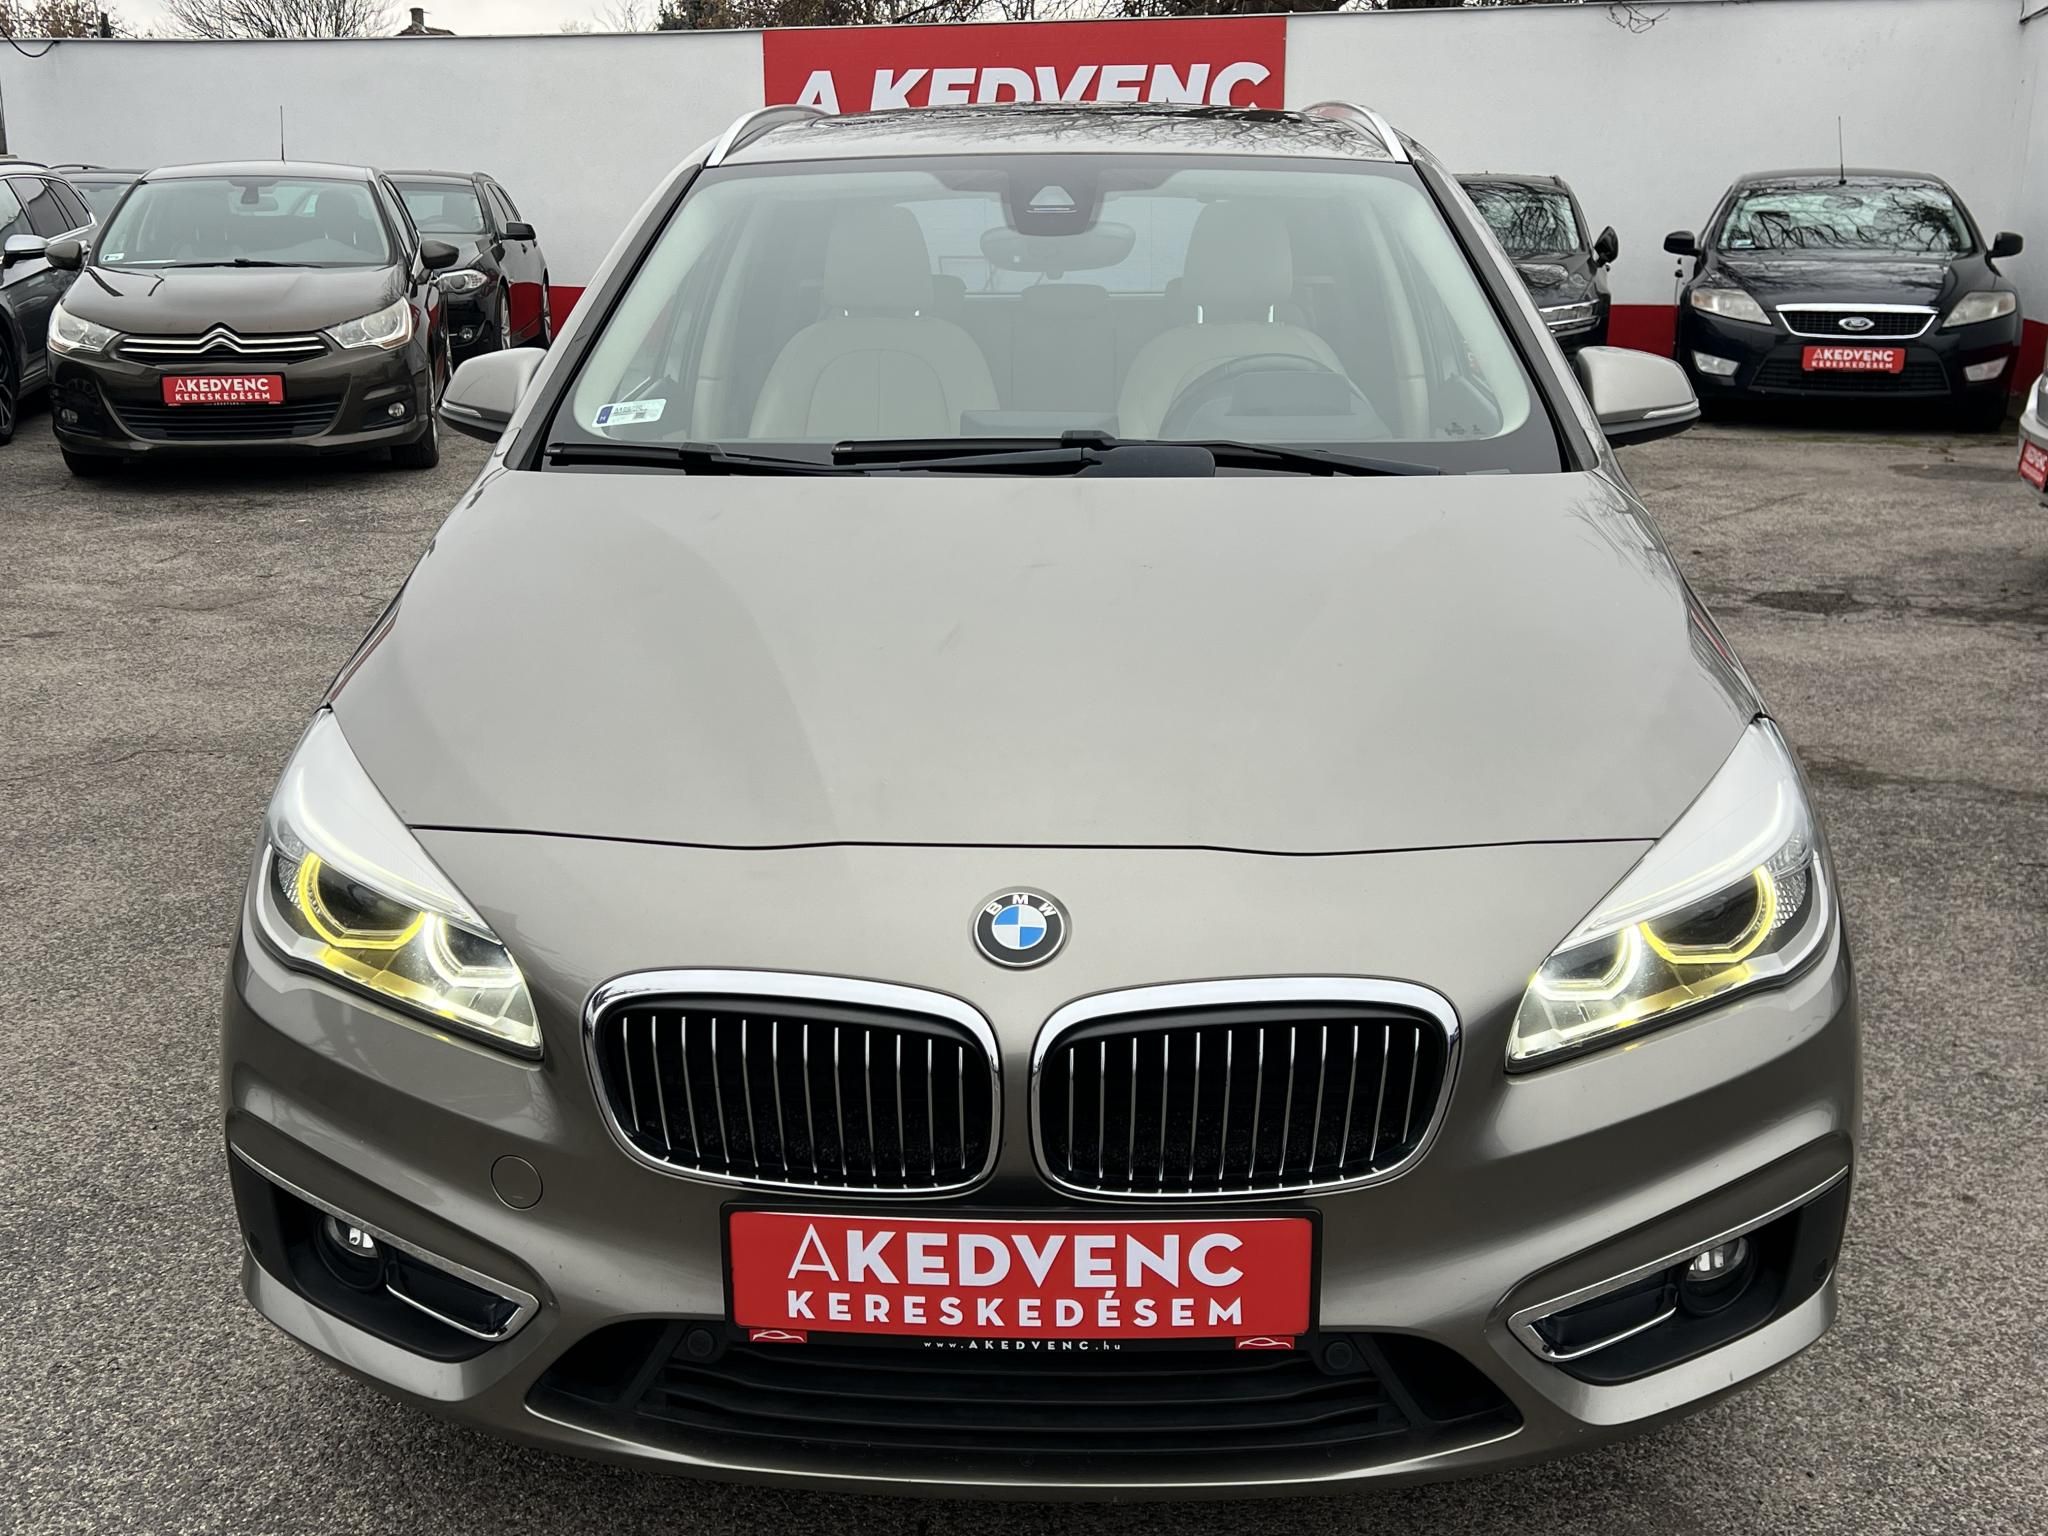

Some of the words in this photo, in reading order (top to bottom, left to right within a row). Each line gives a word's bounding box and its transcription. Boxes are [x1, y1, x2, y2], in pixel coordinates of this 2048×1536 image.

[796, 70, 842, 116] A
[870, 60, 1272, 111] KEDVENC
[1813, 349, 1894, 361] AKEDVENC
[175, 378, 269, 392] AKEDVENC
[175, 391, 270, 401] KERESKEDÉSEM
[986, 894, 1057, 917] BMW
[787, 1223, 1244, 1288] AKEDVENC
[787, 1290, 1242, 1328] KERESKEDÉSEM
[923, 1340, 1121, 1351] www.AKEDVENC.hu
